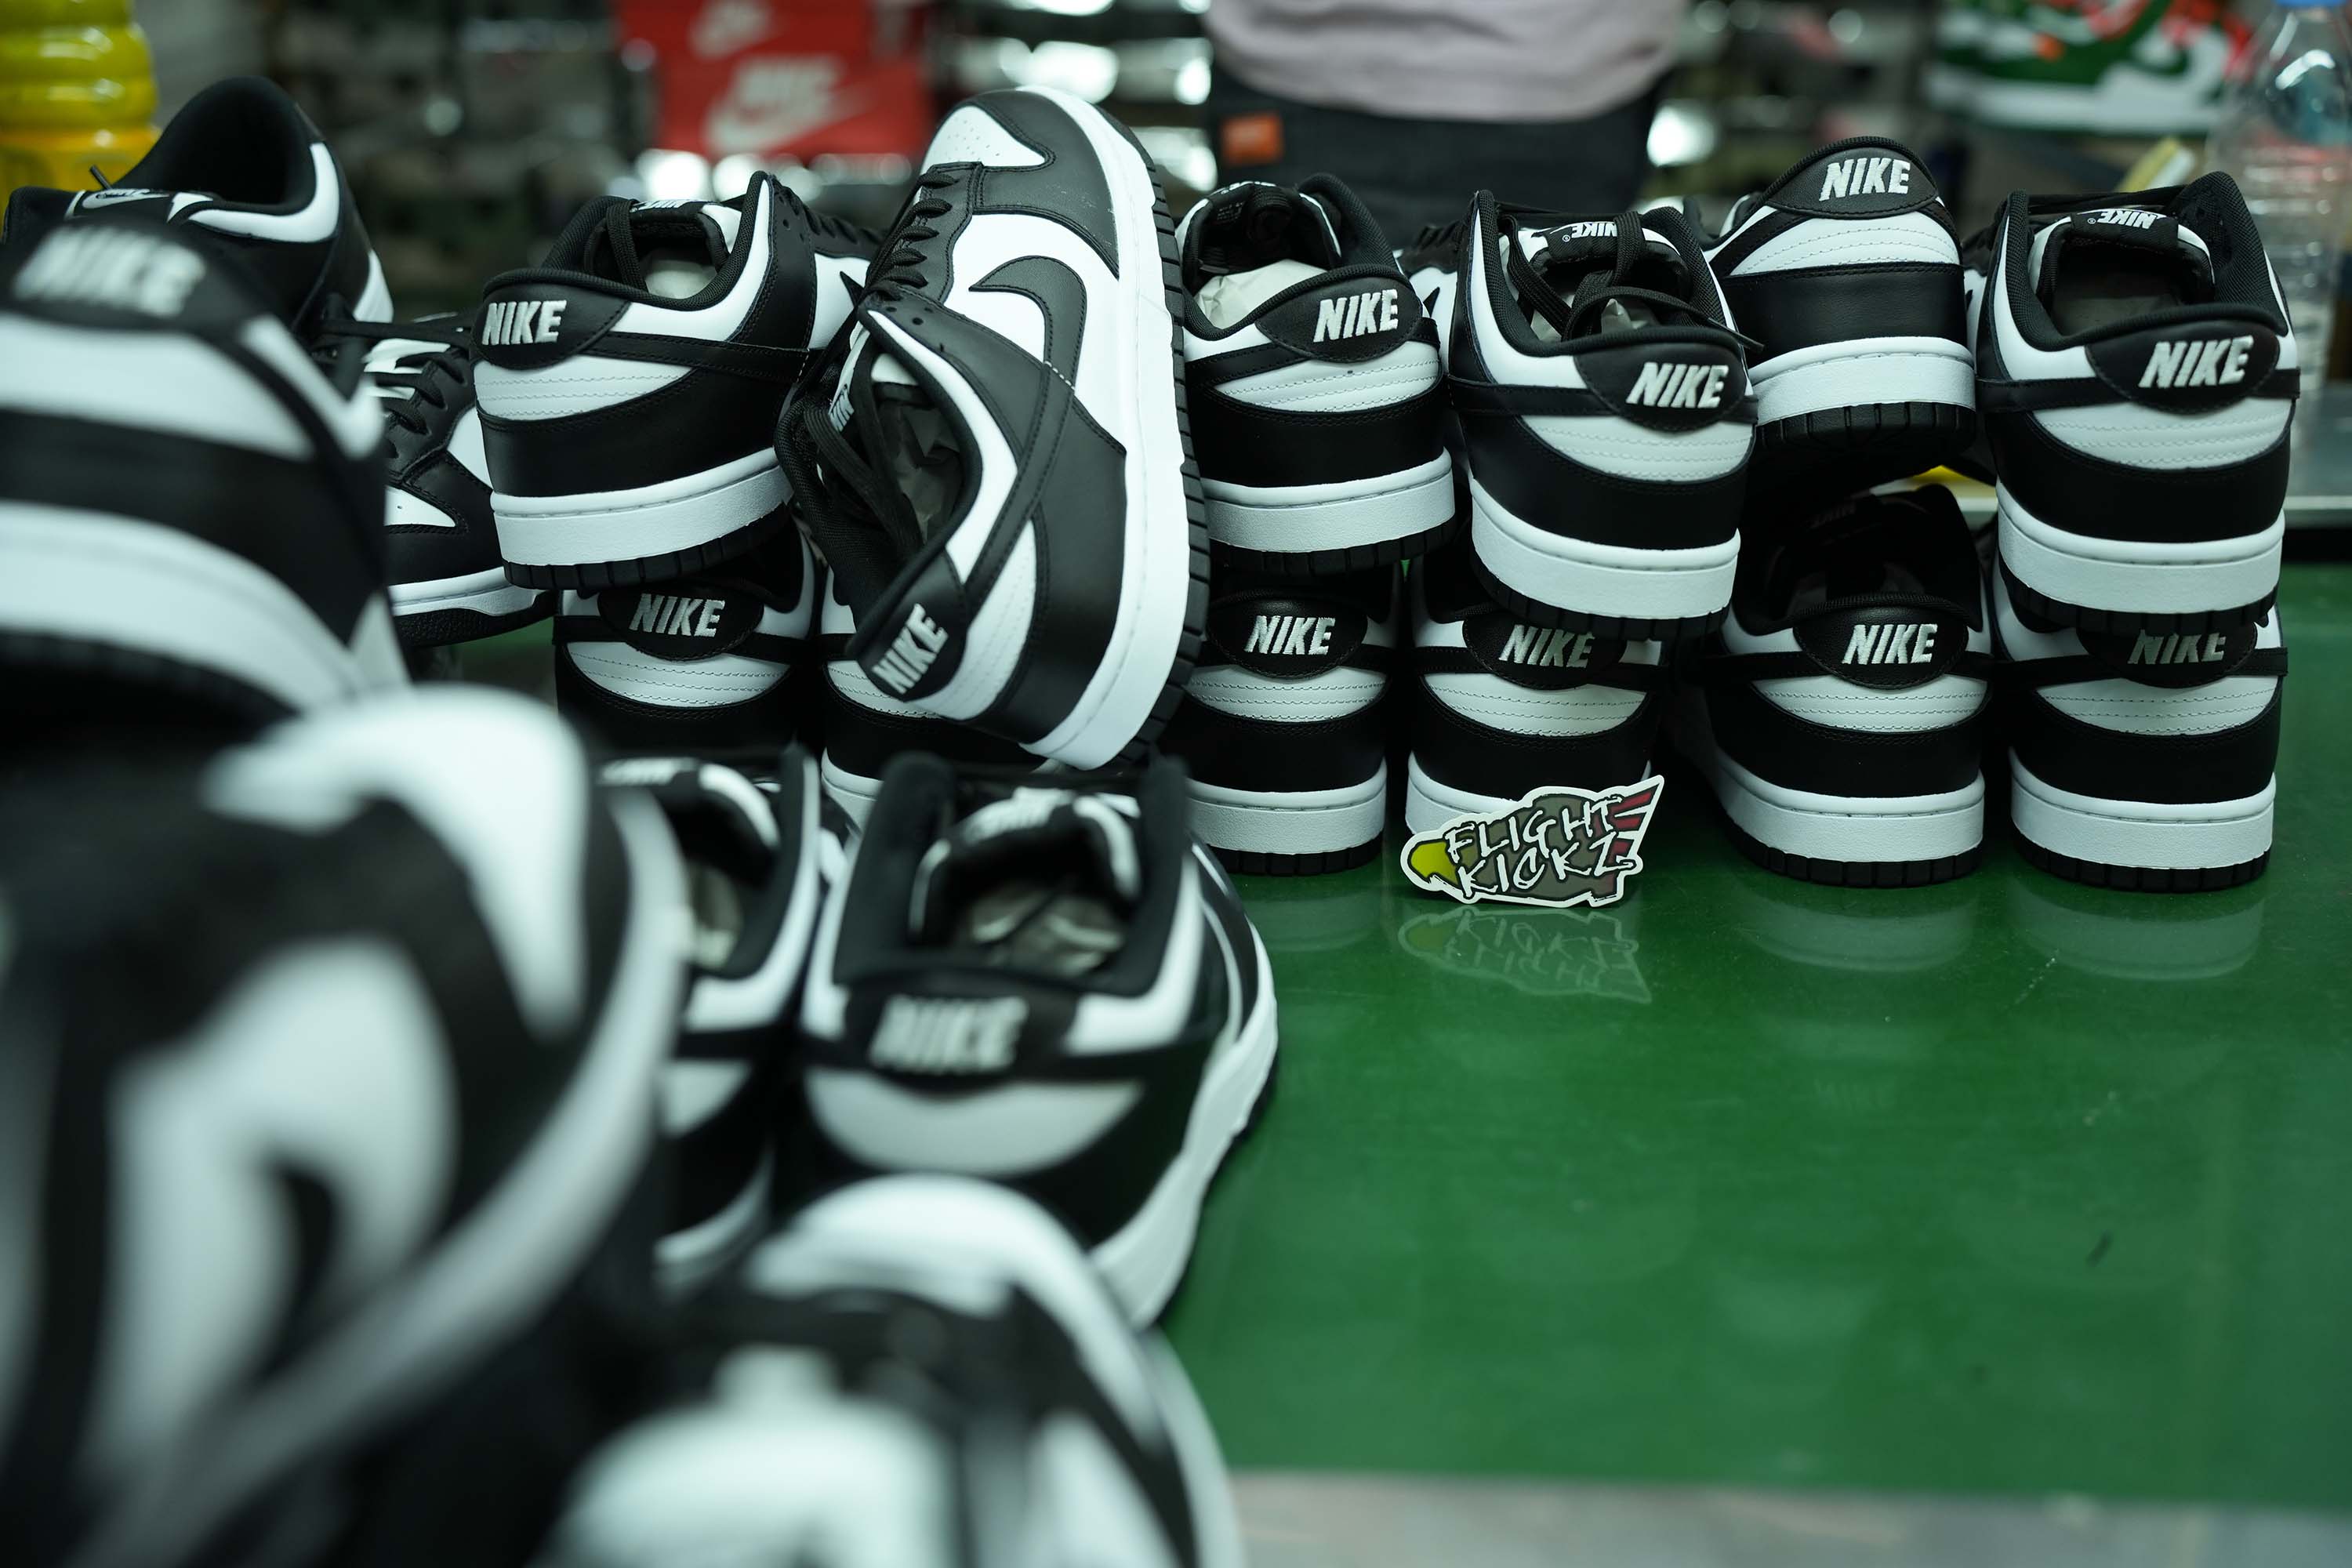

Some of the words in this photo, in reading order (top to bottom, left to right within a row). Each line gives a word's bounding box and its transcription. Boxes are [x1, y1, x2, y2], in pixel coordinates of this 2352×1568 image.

[1819, 157, 1911, 201] NIKE
[481, 299, 567, 346] NIKE
[1313, 289, 1399, 343] NIKE
[1625, 361, 1730, 408] NIKE
[2137, 335, 2254, 388] NIKE
[628, 593, 726, 637] NIKE
[1243, 615, 1336, 655] NIKE
[871, 603, 949, 695] NIKE
[1498, 624, 1595, 668] NIKE
[1841, 623, 1938, 665] NIKE
[1444, 794, 1623, 863] FLIGHT
[1457, 832, 1636, 898] KICKZ
